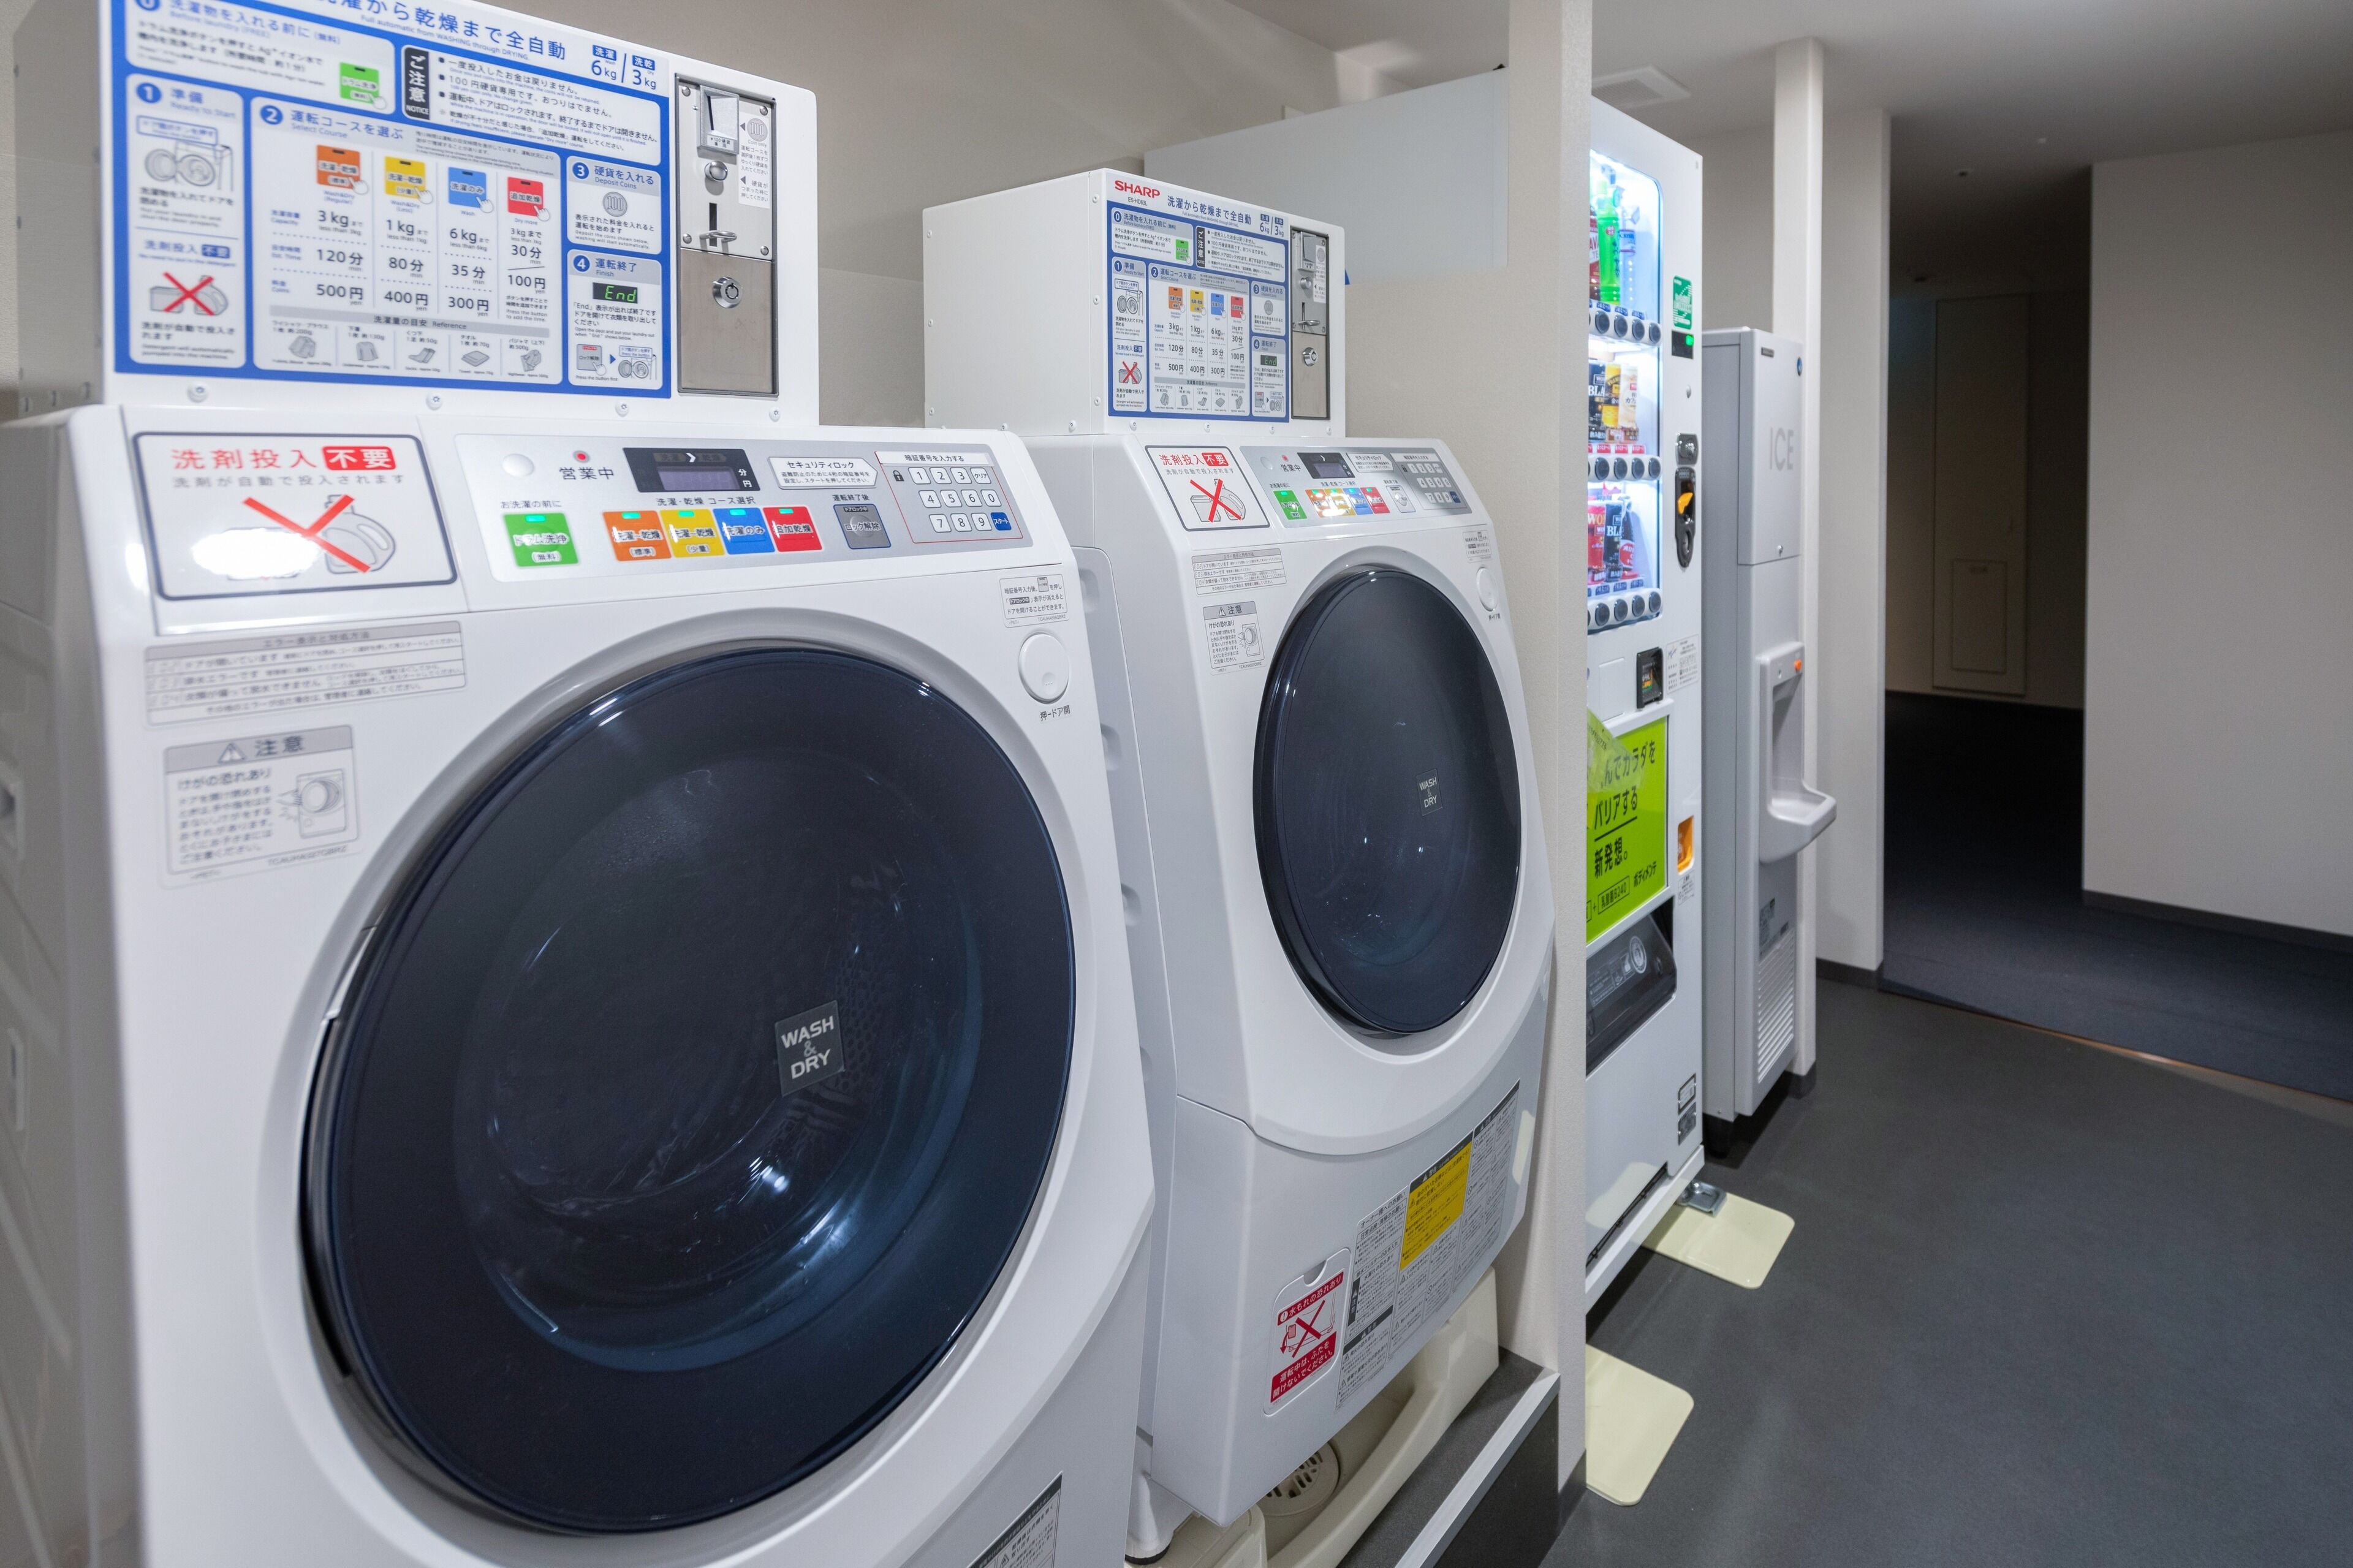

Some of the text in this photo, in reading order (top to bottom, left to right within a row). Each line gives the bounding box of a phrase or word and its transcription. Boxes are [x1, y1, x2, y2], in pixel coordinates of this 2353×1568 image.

[318, 0, 566, 60] 濯から乾燥まで全自動
[378, 19, 415, 32] automatic
[436, 33, 471, 47] WASHING
[472, 42, 501, 55] through
[594, 46, 615, 60] 洗濯
[591, 60, 616, 80] 6 kg
[634, 56, 653, 70] 洗乾
[409, 55, 427, 103] ご注意
[632, 69, 656, 89] 3 kg
[144, 86, 153, 101] 1
[171, 89, 203, 104] 準備
[406, 105, 429, 115] NOTICE
[291, 110, 403, 139] 運転コースを選ぶ
[292, 123, 347, 138] Select Course
[577, 165, 585, 176] 3
[594, 165, 654, 185] 硬貨を入れる
[452, 183, 483, 194] 洗濯のみ
[595, 177, 619, 186] Deposit
[741, 186, 768, 195] つまった時に
[1115, 180, 1161, 198] SHARP
[510, 192, 540, 203] 追加乾燥
[1128, 197, 1148, 206] ES-HD63L
[1168, 195, 1251, 225] 洗濯から乾燥まで全自動
[317, 211, 349, 227] 3 kg
[575, 214, 654, 232] 表示された料金を入れると
[1124, 213, 1167, 227] 洗濯物を入れる前に
[386, 219, 414, 236] 1 kg
[517, 229, 525, 237] kg
[575, 222, 622, 233] 運転を始めます
[1260, 222, 1264, 232] 6
[1275, 225, 1279, 235] 3
[450, 229, 477, 244] 6 kg
[596, 258, 637, 272] 運転終了
[1161, 268, 1196, 279] 運転コースを選ぶ
[605, 286, 637, 303] End
[1261, 286, 1283, 294] 硬貨を入れる
[374, 316, 427, 327] 洗濯量の目安
[432, 321, 466, 330] Reference
[1173, 324, 1179, 332] kg
[1264, 357, 1277, 366] End
[1769, 426, 1794, 471] ICE
[172, 449, 392, 471] 洗剤投入 不要
[1159, 454, 1227, 466] 洗剤投入 不要
[559, 466, 615, 481] 営業中
[738, 468, 747, 477] 分
[917, 472, 922, 480] 1
[172, 474, 405, 489] 洗剤が自動で投入されます
[501, 499, 562, 509] お洗濯の前に
[708, 496, 756, 506] コース選択
[928, 494, 995, 503] 4 5 6 0
[936, 519, 942, 528] 7
[958, 518, 965, 527] 8
[978, 517, 985, 526] 9
[1228, 605, 1242, 615] 注意
[1209, 620, 1234, 629] けがの恐れあり
[254, 736, 305, 757] 注意
[1419, 777, 1437, 790] WASH
[1427, 788, 1432, 797] &
[1424, 795, 1437, 808] DRY
[1594, 786, 1638, 825] バリアする
[1594, 836, 1627, 879] 新発想。
[781, 1015, 835, 1048] WASH
[803, 1040, 817, 1057] &
[790, 1048, 832, 1080] DRY
[1289, 1275, 1342, 1317] 水もれの恐れあり
[1279, 1341, 1329, 1383] 運転中は、ふたを
[1273, 1351, 1333, 1399] 開けないでください。
